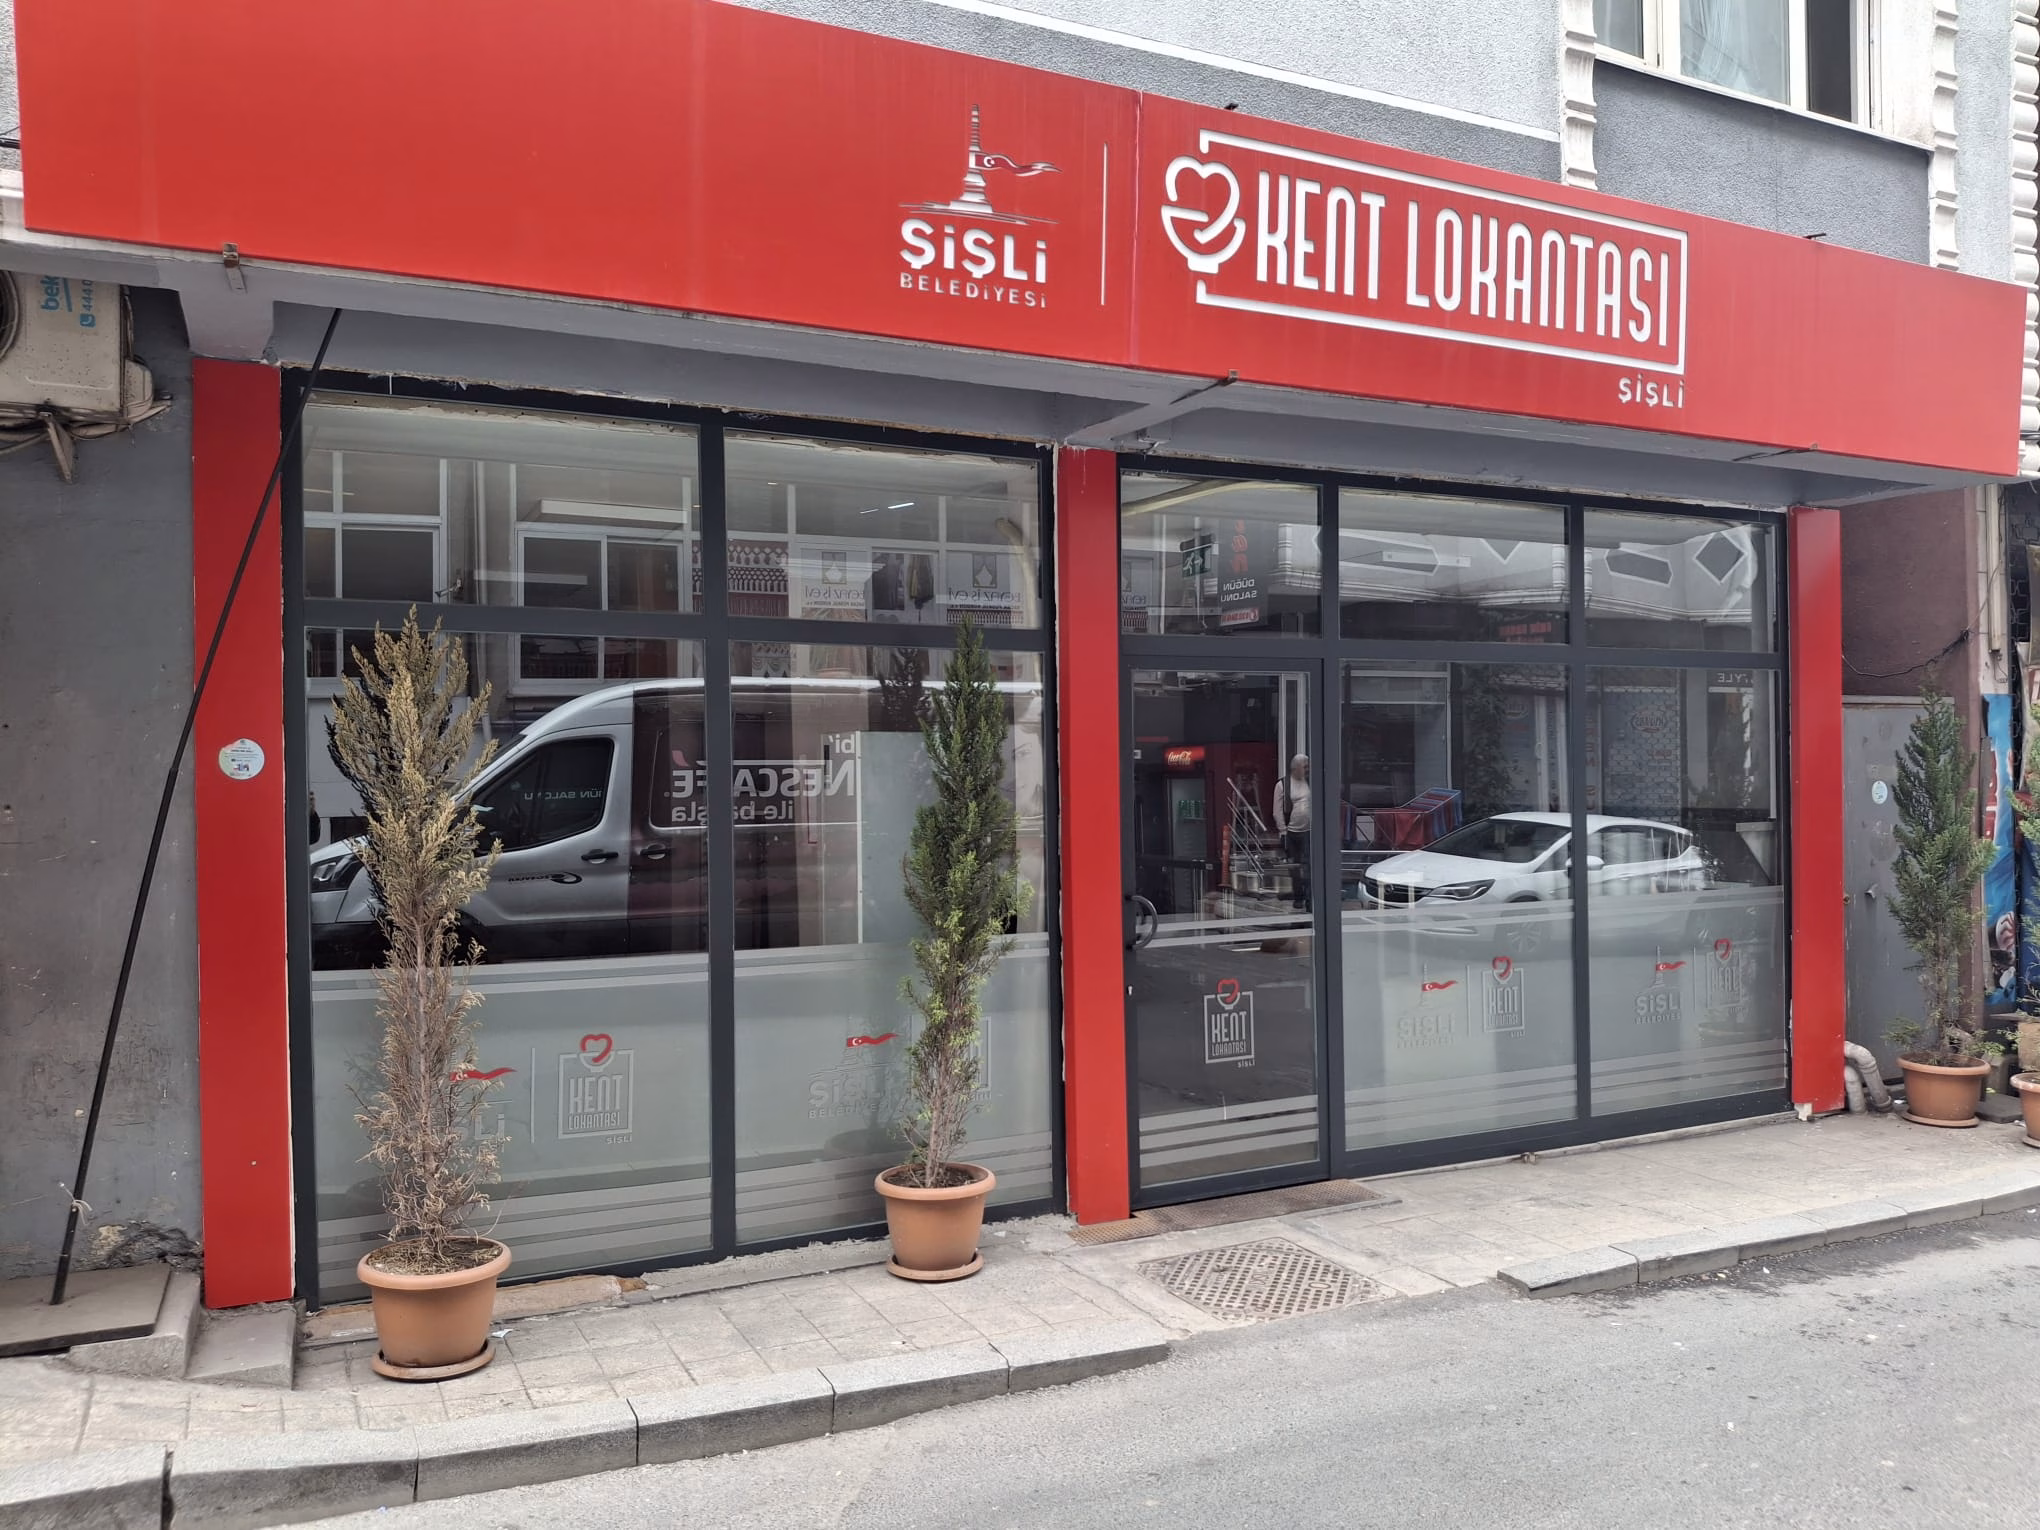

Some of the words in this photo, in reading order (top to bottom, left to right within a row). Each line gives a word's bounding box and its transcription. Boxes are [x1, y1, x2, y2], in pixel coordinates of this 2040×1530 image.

[900, 218, 1047, 284] ŞİŞLİ
[1256, 170, 1386, 300] KENT
[1406, 201, 1669, 347] LOKANTASI
[899, 272, 1047, 309] BELEDİYESİ
[1618, 374, 1686, 410] ŞİŞLİ
[1488, 986, 1519, 1015] KENT
[1211, 1011, 1247, 1043] KENT
[1211, 1040, 1247, 1057] LOKANTASI
[569, 1074, 624, 1114] KENT
[568, 1111, 620, 1130] LOKANTASI
